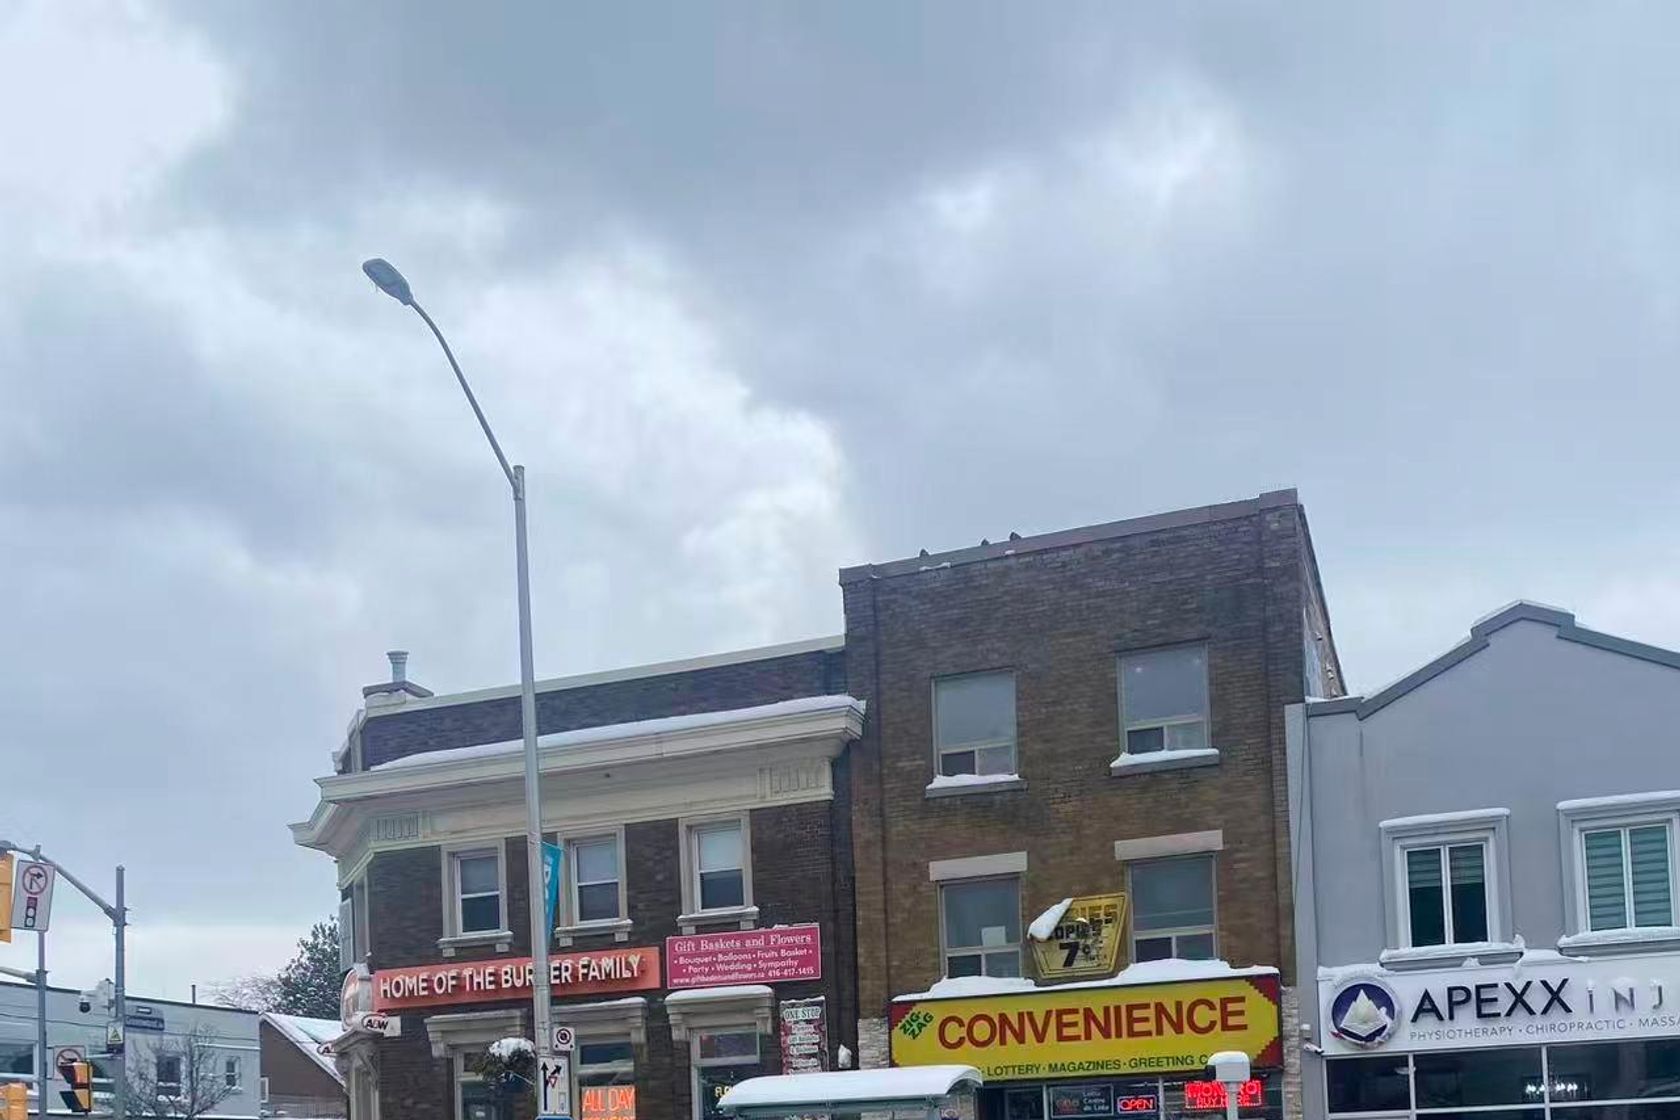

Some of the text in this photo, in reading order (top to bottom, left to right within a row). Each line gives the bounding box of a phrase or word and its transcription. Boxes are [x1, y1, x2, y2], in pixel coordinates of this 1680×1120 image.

[674, 933, 812, 952] Gift Baskets and Flowers
[679, 948, 807, 966] Bouquet Balloons Fruits Basket
[687, 959, 800, 975] Party Wedding Sympathy
[380, 954, 642, 998] HOME OF THE BURER FAMILY
[1410, 978, 1573, 1023] APEXX
[908, 1012, 935, 1040] ZAG
[937, 996, 1248, 1050] CONVENIENCE
[1410, 1026, 1513, 1041] PHYSIOTHERAPY
[1525, 1019, 1626, 1035] CHIROPRACTIC
[986, 1064, 1042, 1077] LOTTERY
[1048, 1060, 1121, 1073] MAGAZINES
[1129, 1056, 1194, 1069] GREETING
[582, 1088, 635, 1112] ALL DAY
[1119, 1098, 1154, 1111] OPEN
[1196, 1095, 1251, 1108] BUY HRE
